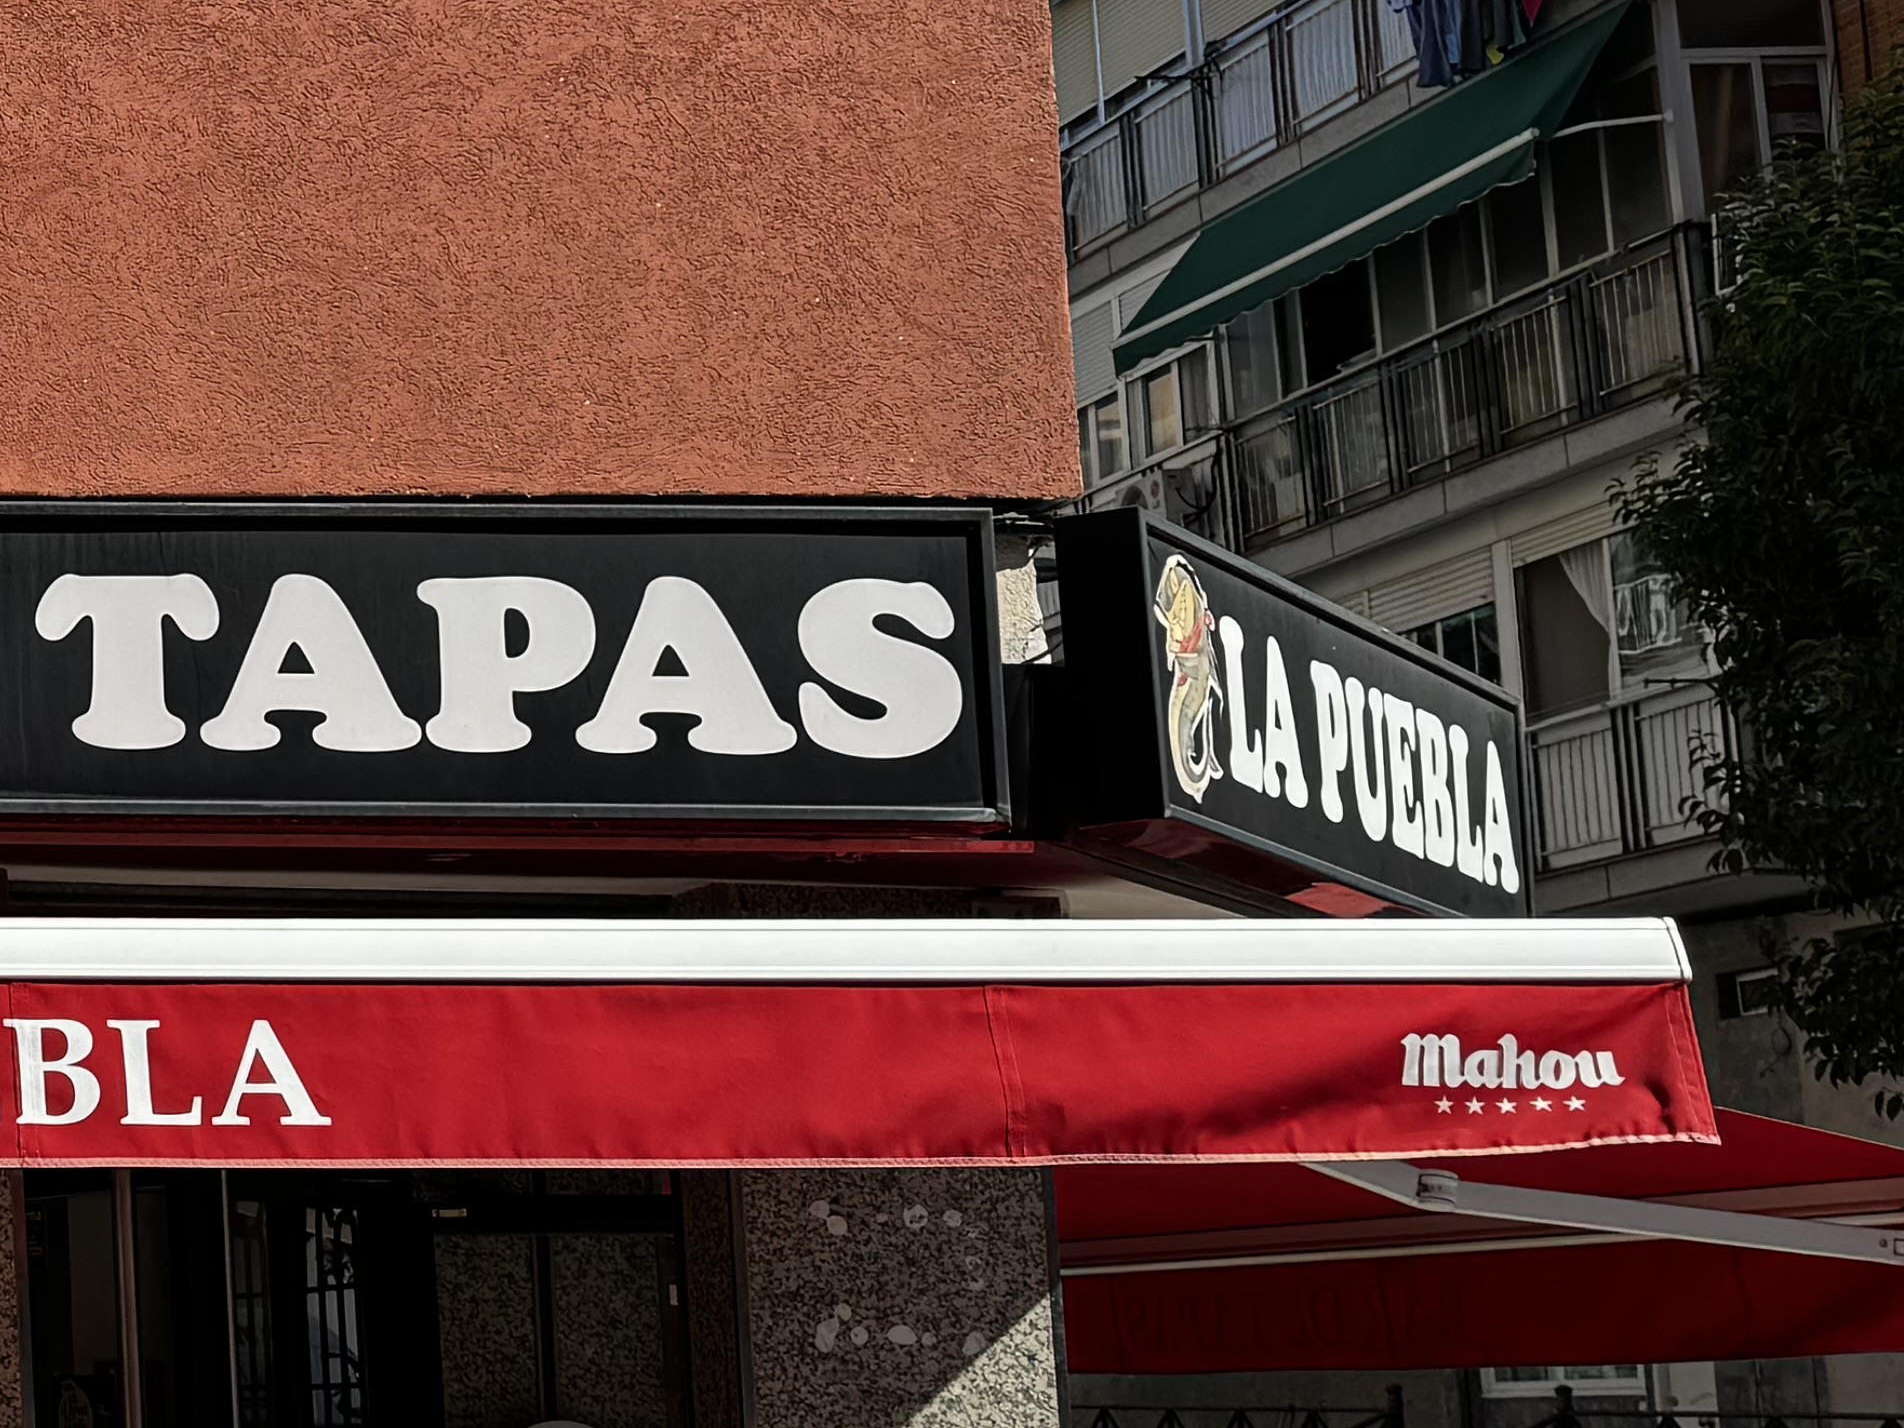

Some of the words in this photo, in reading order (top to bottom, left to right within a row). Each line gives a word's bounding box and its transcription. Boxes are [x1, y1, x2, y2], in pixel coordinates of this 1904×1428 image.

[34, 573, 963, 759] TAPAS
[1218, 615, 1309, 809] LA
[1309, 659, 1520, 894] PUEBLA
[1400, 1033, 1625, 1090] Mahou
